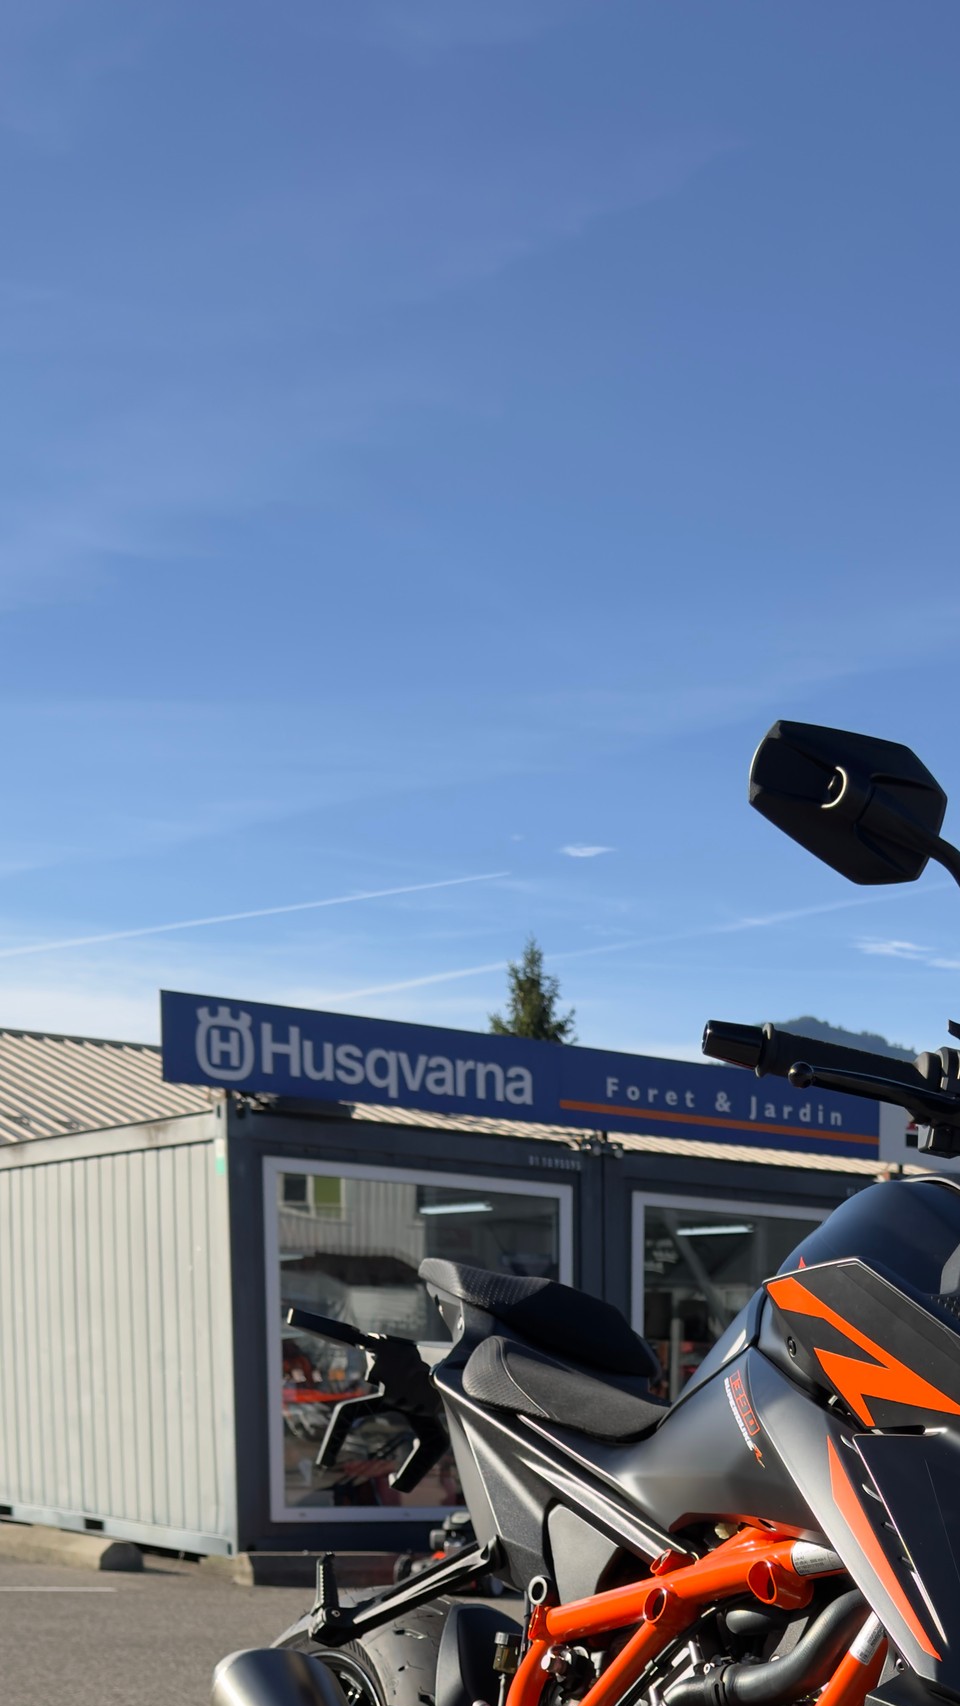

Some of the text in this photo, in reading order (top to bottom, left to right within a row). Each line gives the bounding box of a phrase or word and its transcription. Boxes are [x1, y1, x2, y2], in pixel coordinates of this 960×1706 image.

[260, 1022, 534, 1105] Husqvarna
[606, 1077, 842, 1127] Foret & Jardin
